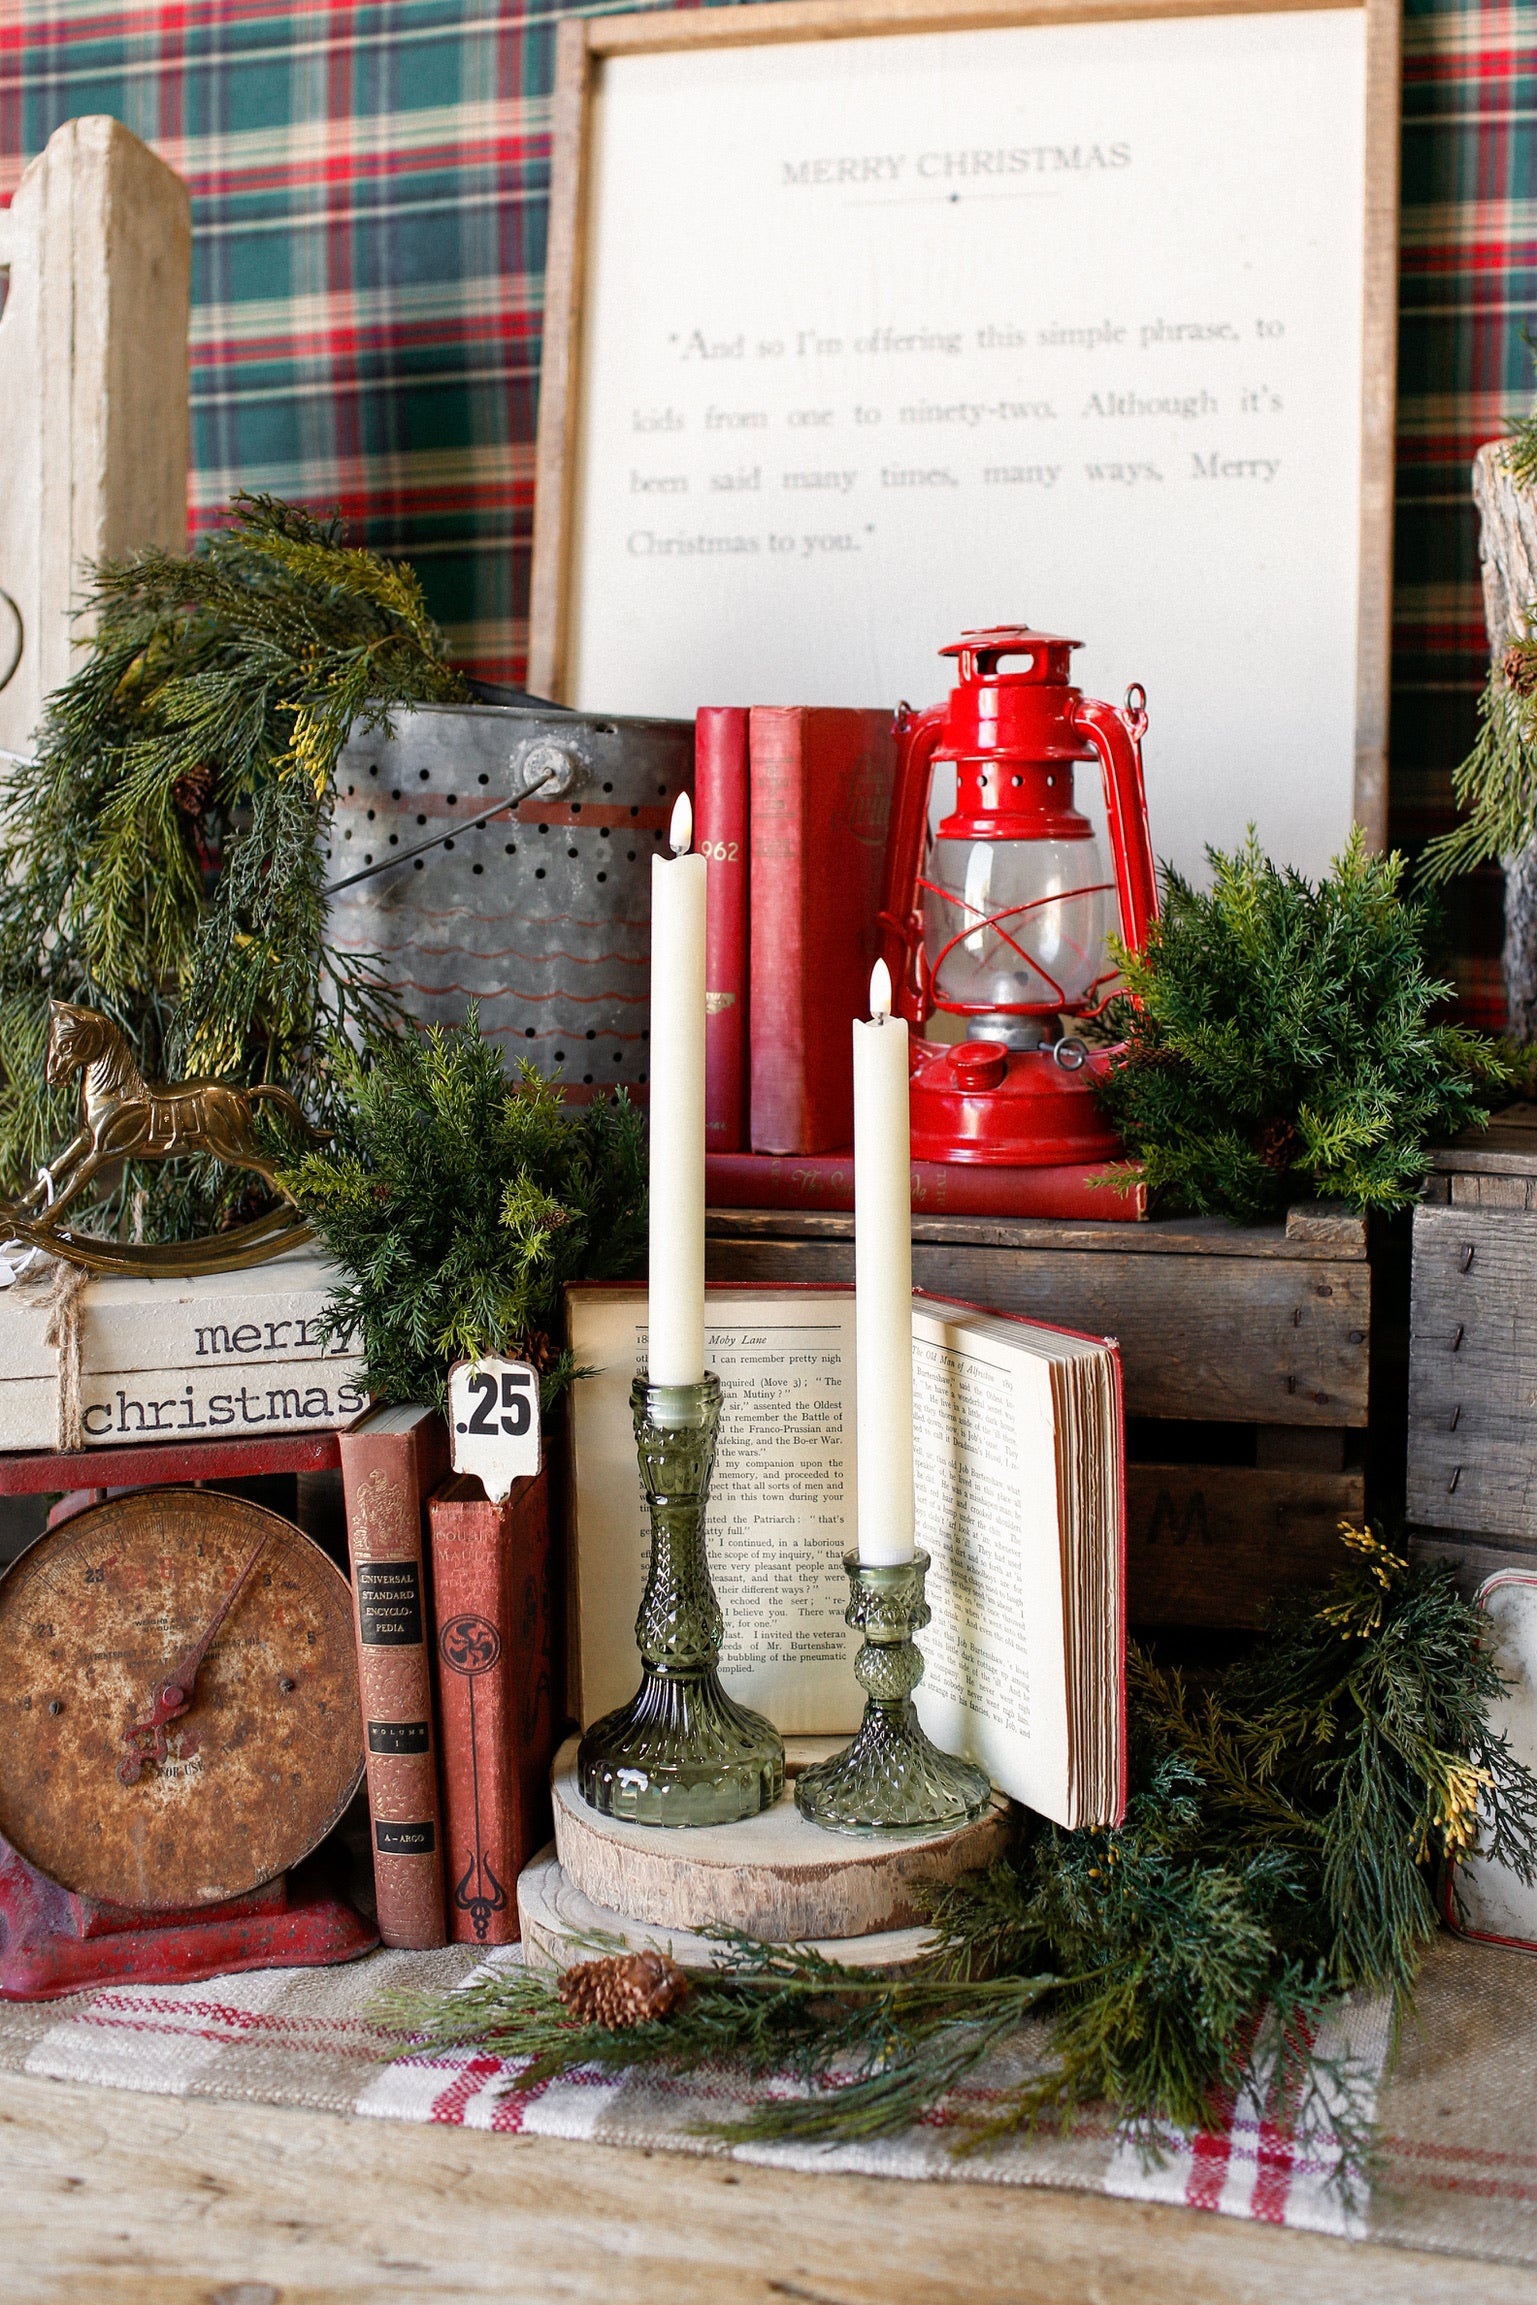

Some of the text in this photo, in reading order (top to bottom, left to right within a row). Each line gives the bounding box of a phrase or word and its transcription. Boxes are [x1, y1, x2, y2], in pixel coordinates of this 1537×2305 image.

[781, 141, 1133, 187] MERRY CHRISTMAS
[757, 336, 784, 359] so
[797, 329, 843, 357] I'm
[854, 327, 963, 357] offering
[977, 321, 1026, 350] this
[1037, 318, 1127, 351] simple
[1256, 316, 1285, 339] to
[631, 406, 685, 433] kids
[704, 403, 768, 431] from
[786, 405, 832, 429] one
[854, 402, 881, 427] to
[1080, 388, 1218, 420] Although
[1241, 382, 1284, 413] it's
[628, 468, 688, 495] been
[708, 466, 761, 493] said
[781, 466, 858, 497] many
[982, 460, 1061, 489] many
[1190, 449, 1283, 484] Merry
[626, 528, 760, 559] Christmas
[767, 531, 795, 554] to
[708, 1335, 767, 1345] Moby Lane
[711, 1354, 842, 1365] I can remember pretty nigh
[939, 1354, 955, 1367] Man
[957, 1361, 964, 1372] of
[760, 1377, 788, 1389] (Move
[815, 1377, 842, 1386] "The
[959, 1381, 971, 1393] said
[456, 1372, 531, 1436] .25
[753, 1401, 795, 1410] assented
[795, 1401, 810, 1410] the
[813, 1400, 842, 1410] Oldest
[82, 1386, 364, 1435] christmas
[734, 1412, 843, 1422] remember the Battle of
[730, 1425, 843, 1434] the Franco-Prussian and
[756, 1436, 843, 1445] and the Bo-er War.
[721, 1448, 766, 1457] the wars."
[725, 1459, 844, 1470] my companion upon the
[718, 1470, 844, 1481] memory, and proceeded to
[732, 1482, 751, 1490] that
[754, 1481, 765, 1490] all
[768, 1482, 790, 1490] sorts
[792, 1481, 802, 1490] of
[826, 1481, 844, 1490] and
[727, 1493, 736, 1501] in
[740, 1492, 758, 1501] this
[789, 1492, 818, 1503] during
[822, 1494, 844, 1503] your
[942, 1492, 968, 1510] hair and
[733, 1515, 748, 1524] the
[719, 1538, 724, 1547] I
[728, 1539, 774, 1548] continued,
[778, 1539, 788, 1547] in
[803, 1538, 845, 1547] laborious
[708, 1550, 723, 1559] the
[724, 1552, 749, 1561] scope
[750, 1551, 761, 1559] of
[762, 1552, 776, 1561] my
[778, 1551, 815, 1561] inquiry,
[730, 1563, 751, 1572] very
[754, 1562, 791, 1573] pleasant
[795, 1562, 824, 1573] people
[751, 1573, 846, 1584] and that they were
[718, 1585, 739, 1594] their
[741, 1585, 780, 1594] different
[362, 1590, 414, 1601] STANDARD
[730, 1597, 761, 1606] echoed
[768, 1597, 783, 1606] the
[725, 1608, 730, 1616] I
[733, 1608, 764, 1617] believe
[768, 1609, 788, 1619] you.
[799, 1608, 824, 1616] There
[376, 1623, 405, 1633] PEDIA
[738, 1619, 750, 1629] for
[725, 1630, 846, 1640] last. I invited the veteran
[750, 1641, 846, 1651] of Mr. Burtenshaw.
[727, 1652, 847, 1664] bubbling of the pneumatic
